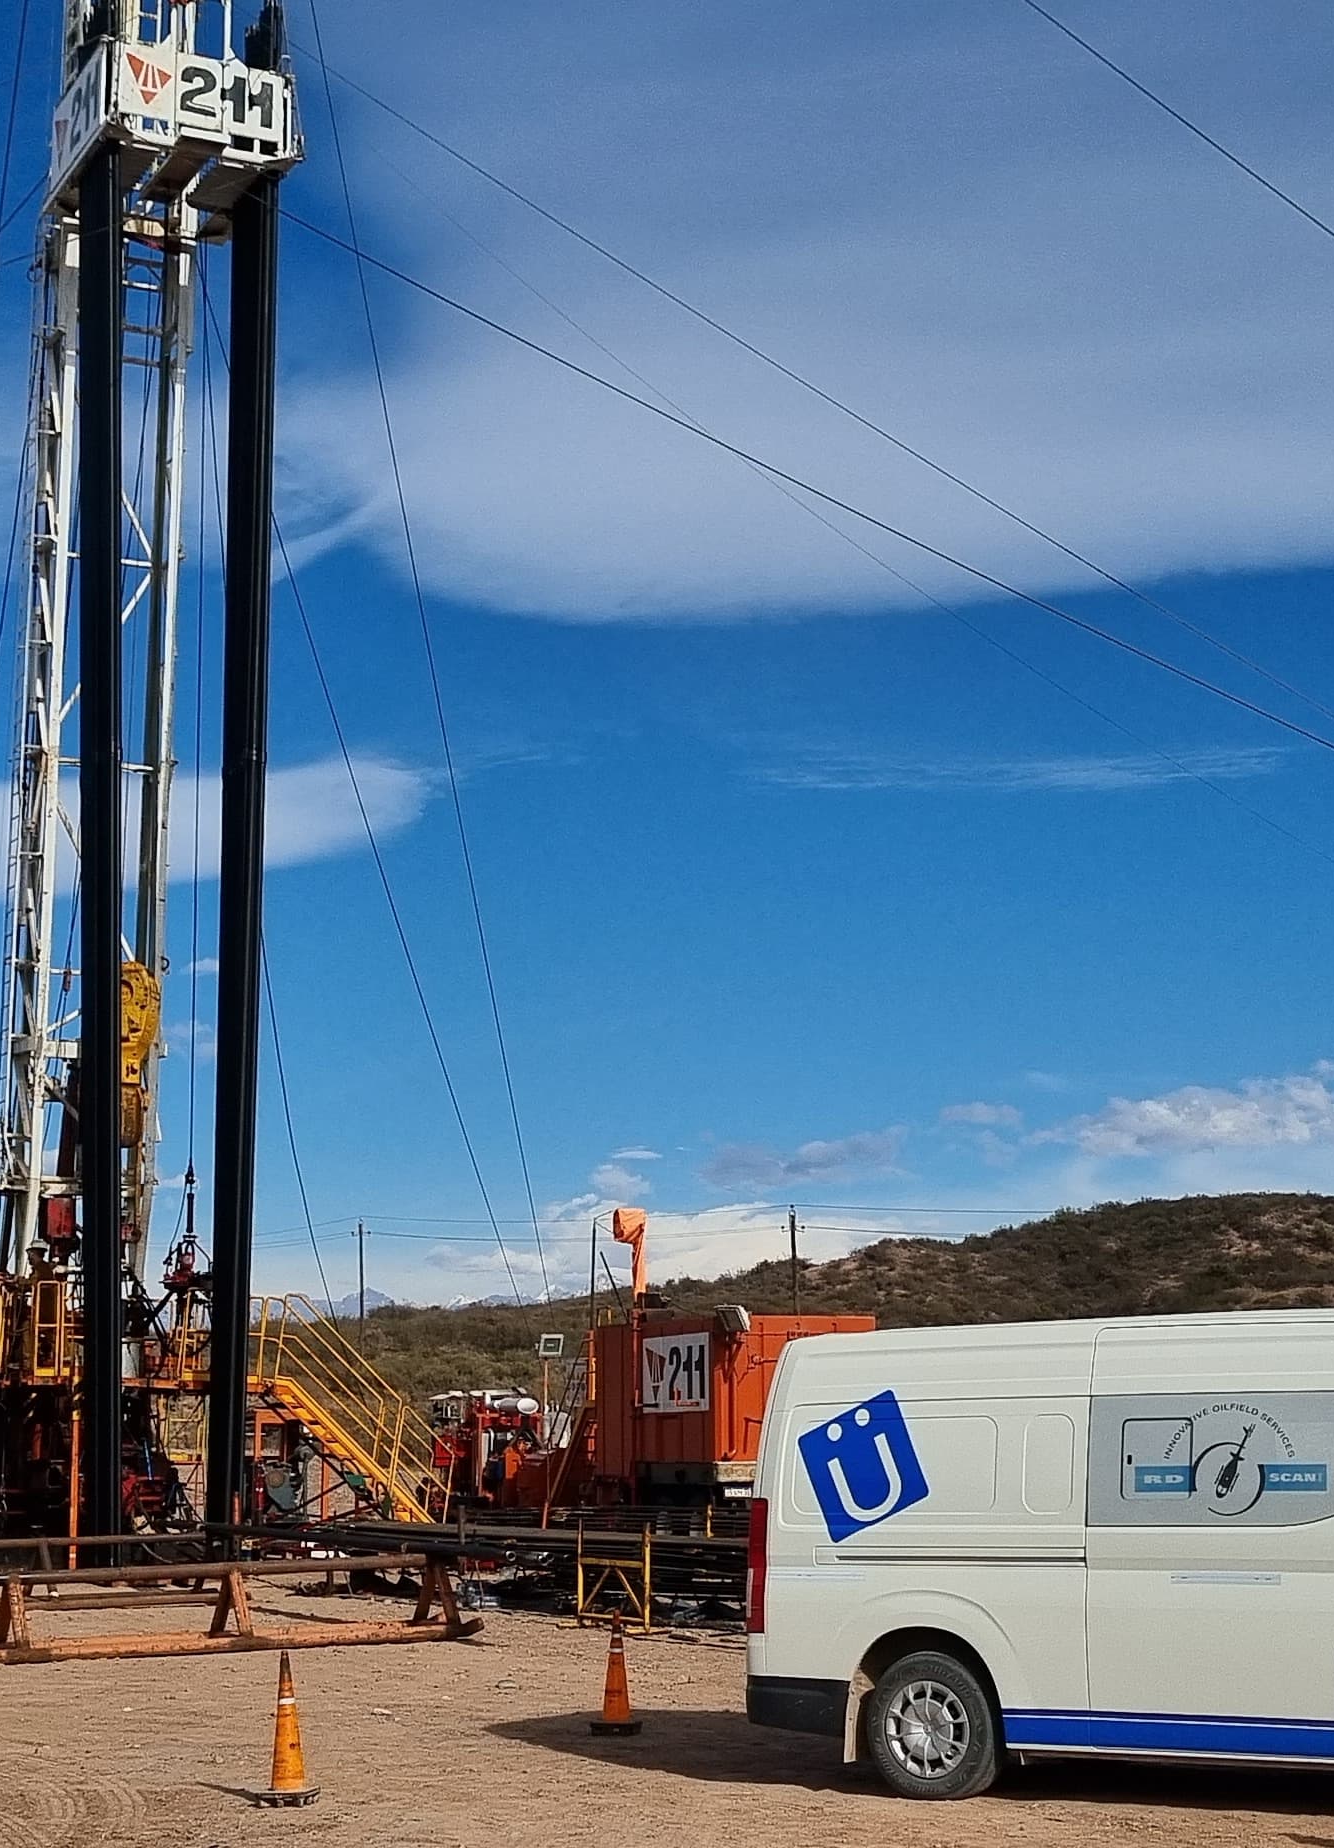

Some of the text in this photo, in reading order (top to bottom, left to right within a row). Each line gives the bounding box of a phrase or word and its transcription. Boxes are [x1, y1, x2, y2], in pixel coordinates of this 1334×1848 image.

[70, 60, 100, 153] 211
[180, 66, 273, 129] 211
[668, 1345, 705, 1401] 211
[1163, 1402, 1295, 1460] INNOVAIVE OILFIELD SERVICES
[826, 1408, 902, 1522] Ü
